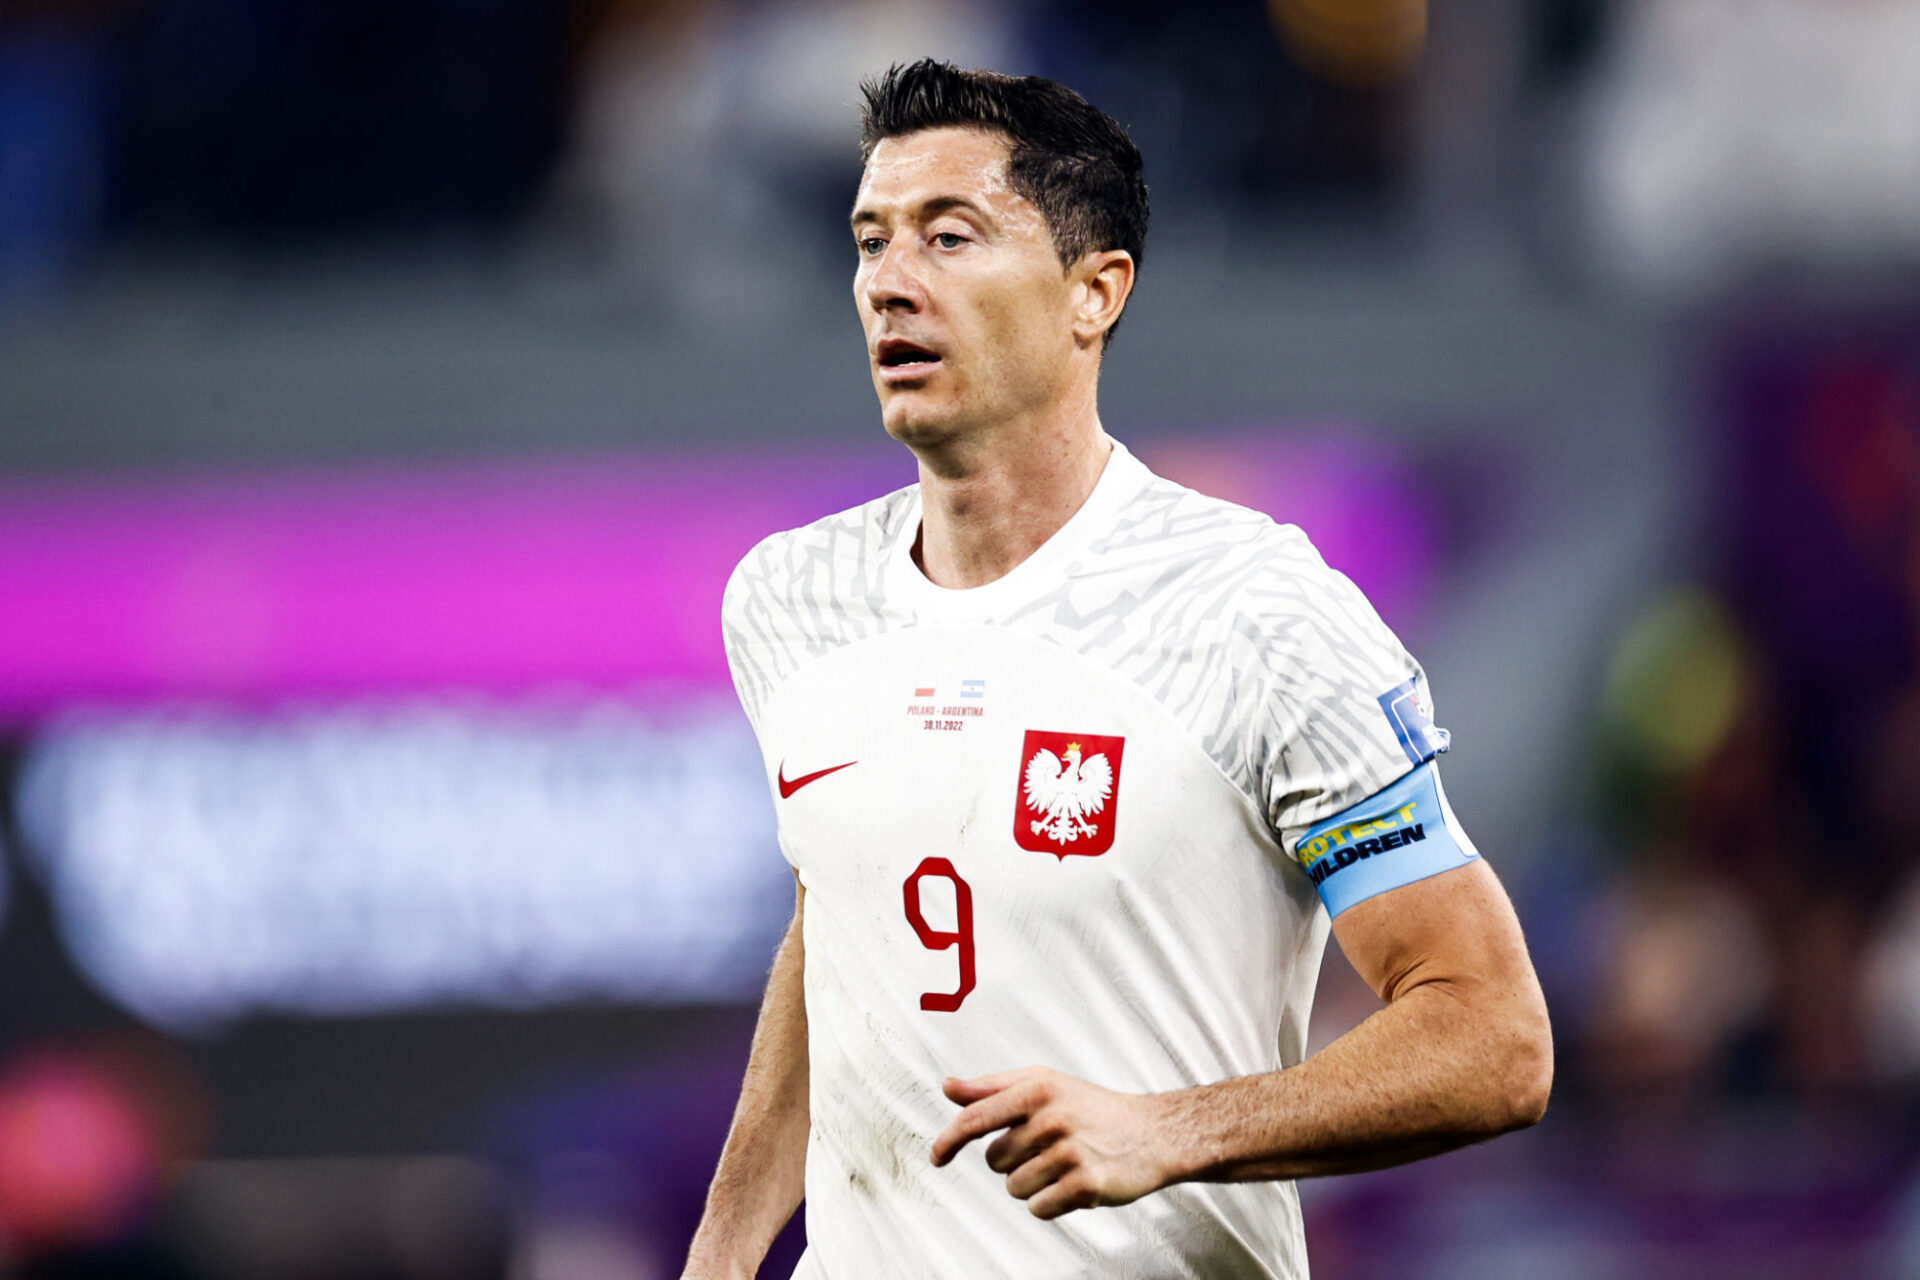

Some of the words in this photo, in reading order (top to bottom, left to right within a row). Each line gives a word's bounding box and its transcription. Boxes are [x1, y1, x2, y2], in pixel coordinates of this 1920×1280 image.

[907, 705, 936, 716] POLAND
[941, 706, 984, 717] ARGENTINA
[923, 720, 964, 731] 30.11.2022
[903, 857, 976, 1012] 9
